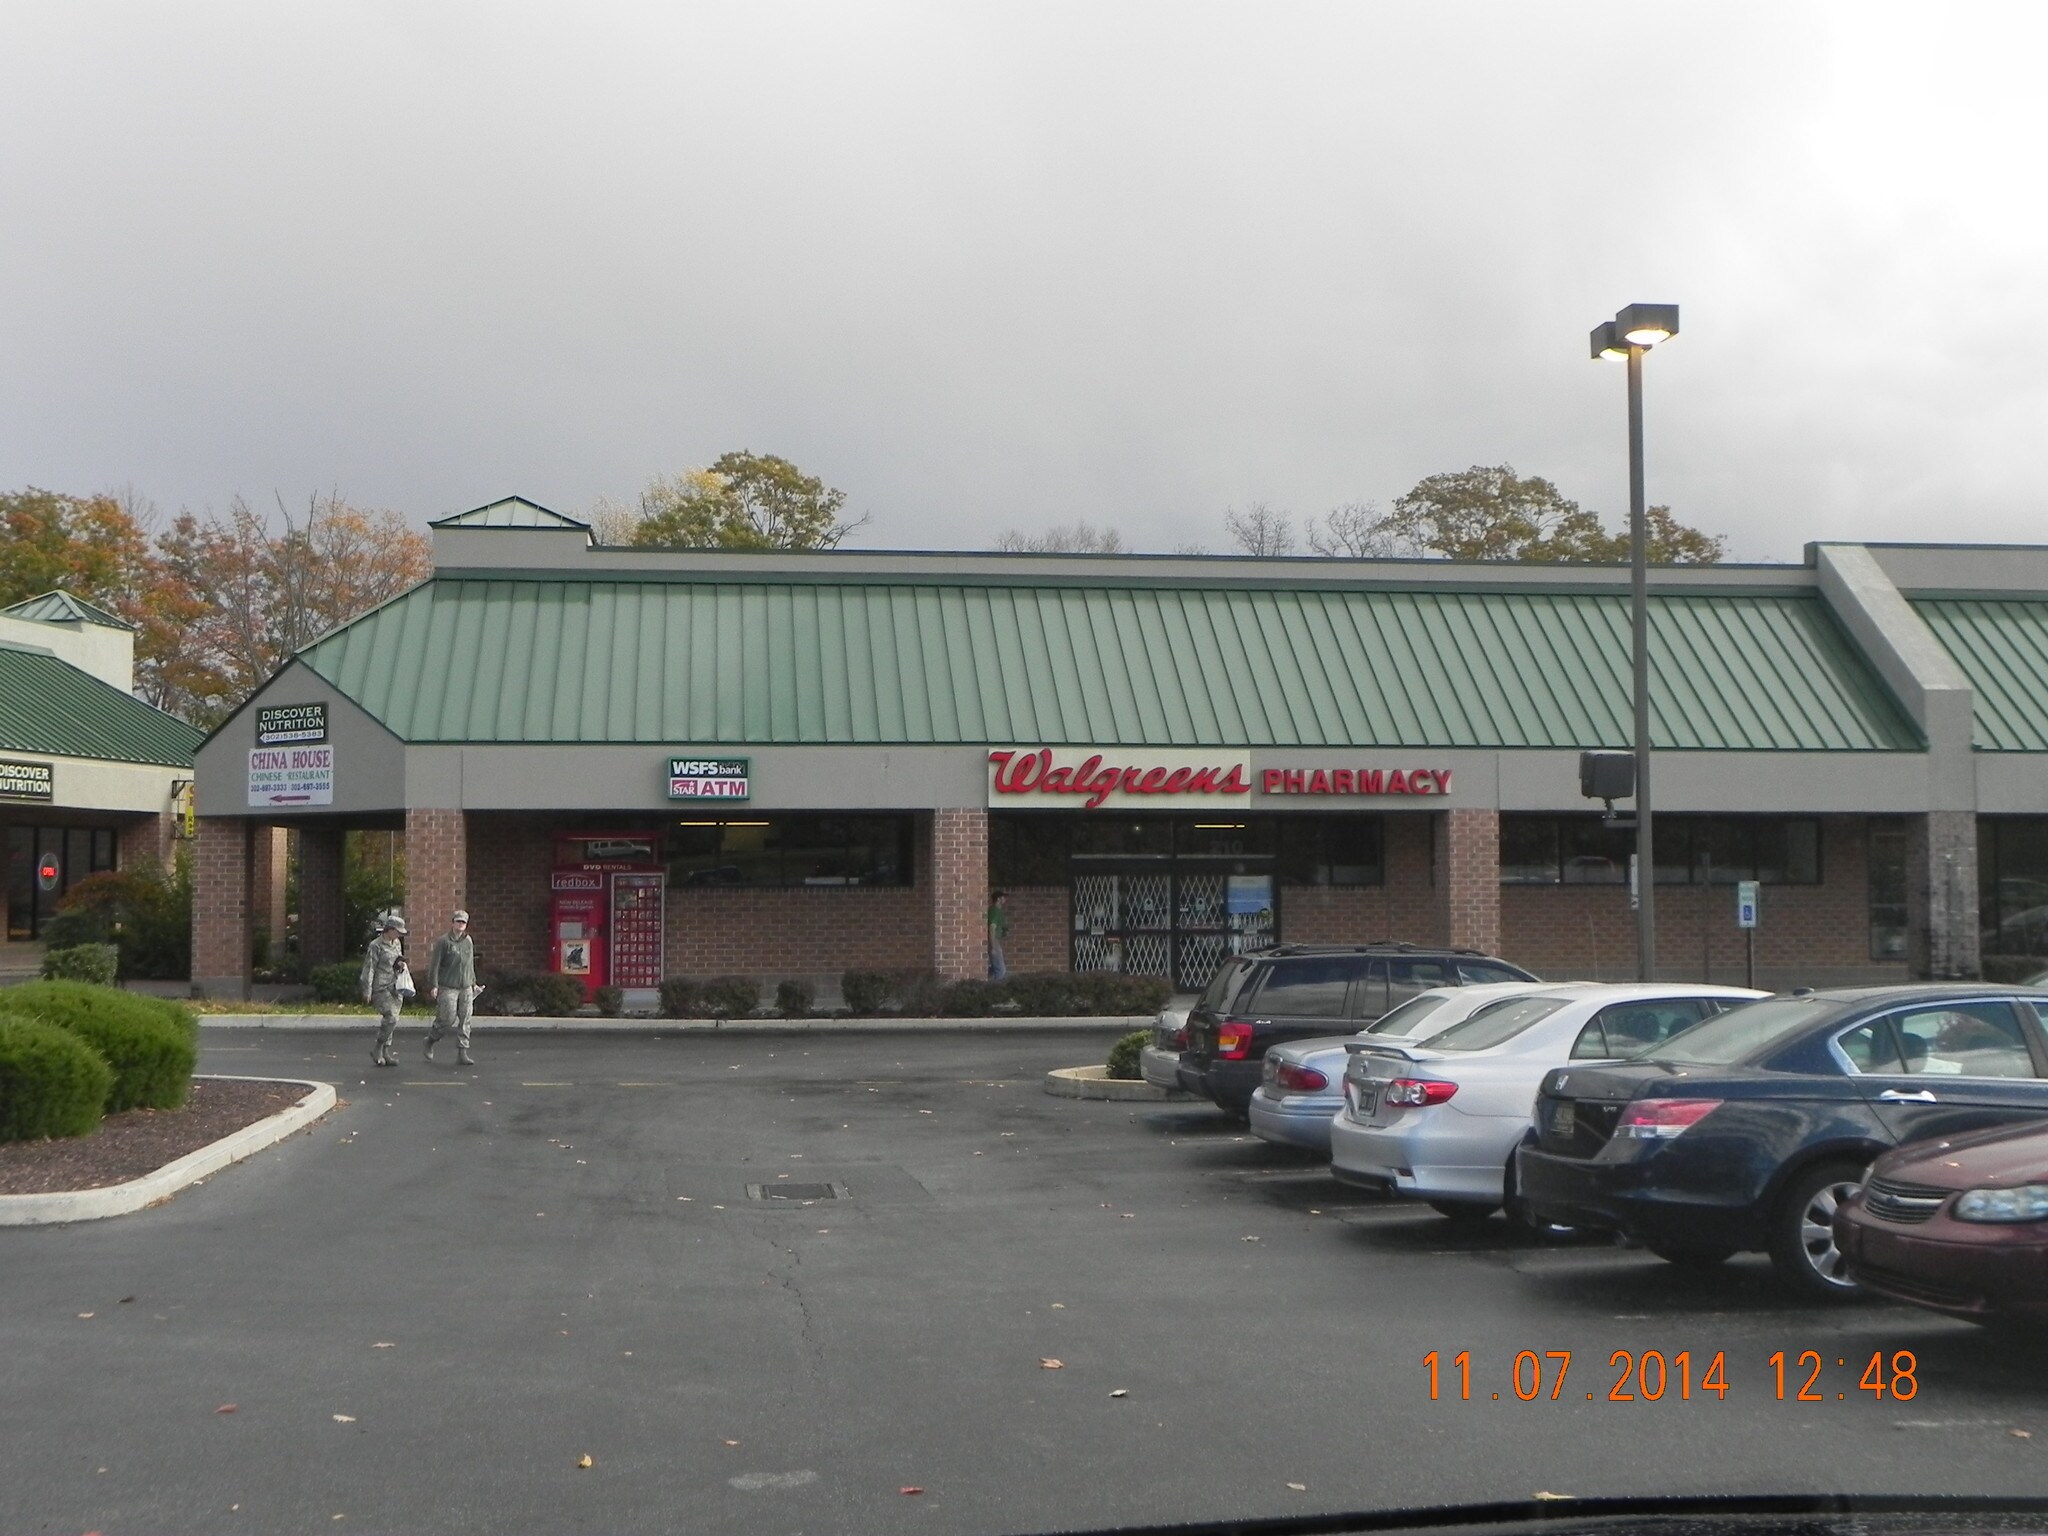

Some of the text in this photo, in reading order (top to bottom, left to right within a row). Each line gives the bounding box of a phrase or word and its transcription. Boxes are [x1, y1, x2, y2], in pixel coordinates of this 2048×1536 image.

[262, 706, 322, 721] DISCOVER
[259, 717, 325, 732] NUTRITION
[251, 749, 331, 770] CHINA HOUSE
[251, 769, 331, 782] CHINESE RESTAURANT
[672, 761, 742, 775] WSFS bank
[988, 747, 1453, 808] Walgreens PHARMACY
[673, 786, 696, 796] STAR
[700, 780, 746, 796] ATM
[556, 877, 597, 888] redbox
